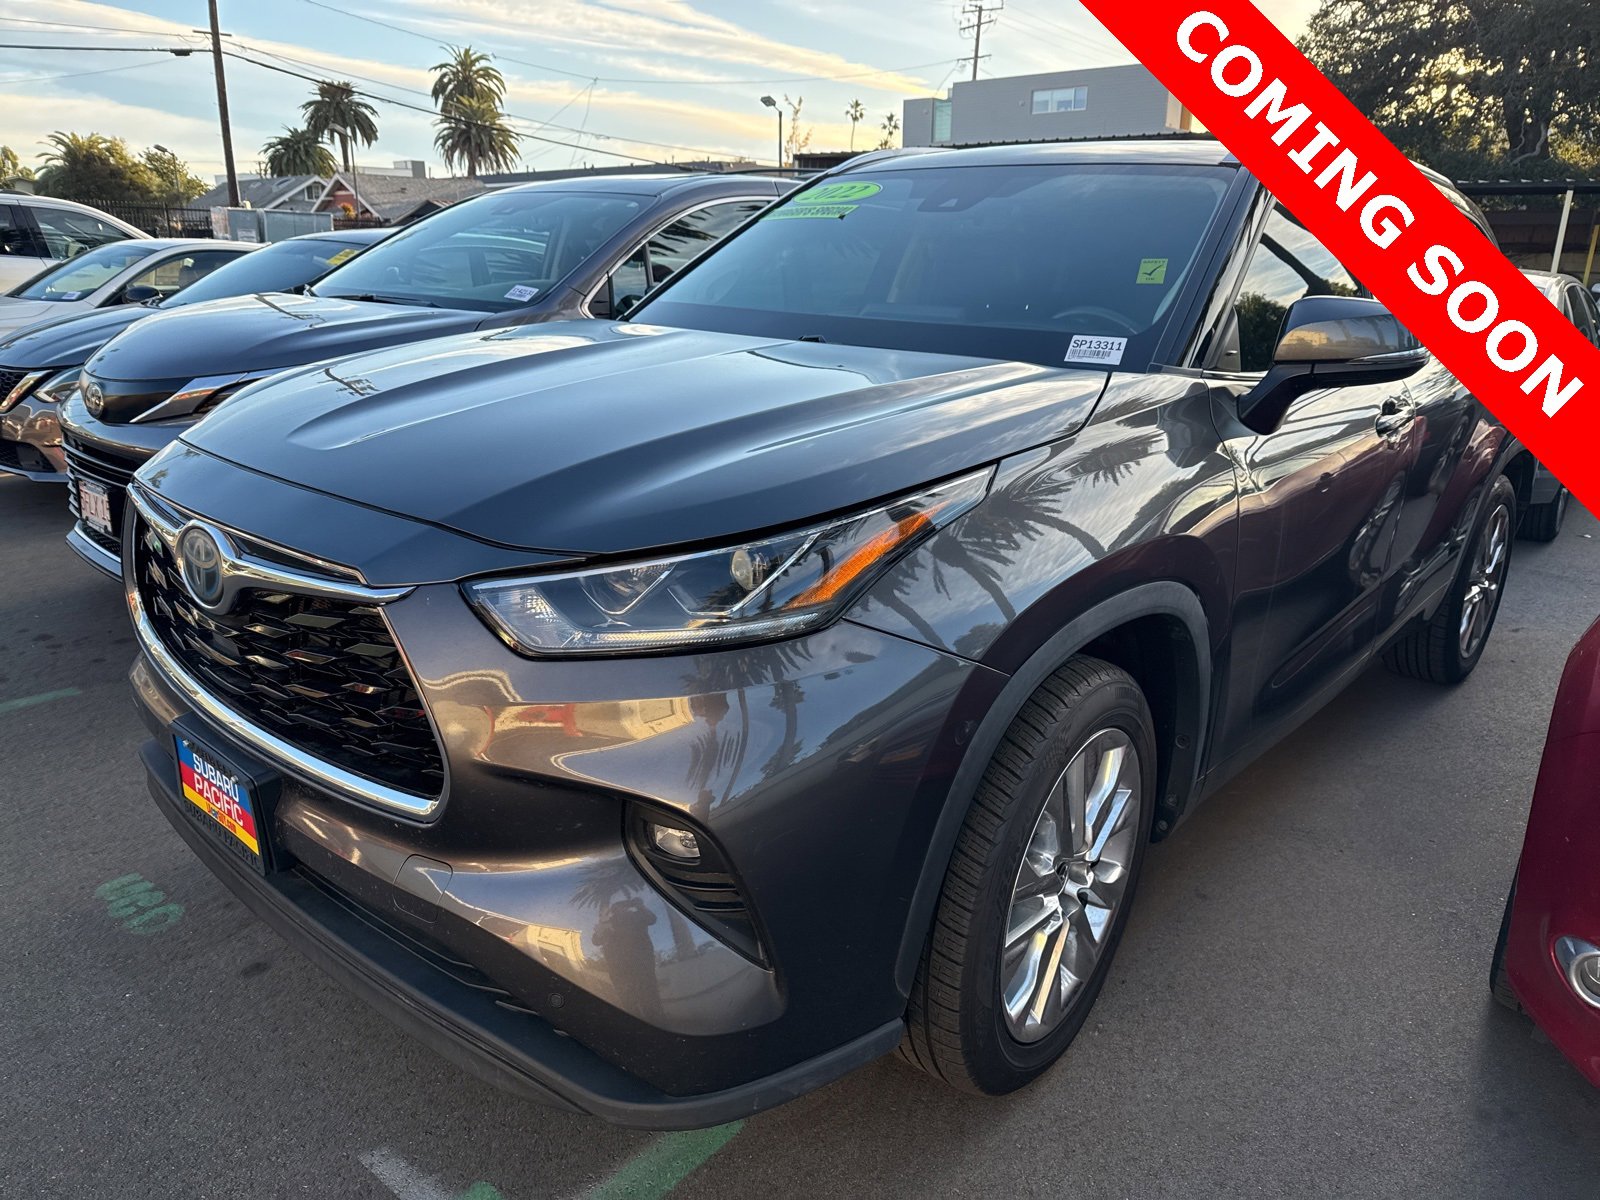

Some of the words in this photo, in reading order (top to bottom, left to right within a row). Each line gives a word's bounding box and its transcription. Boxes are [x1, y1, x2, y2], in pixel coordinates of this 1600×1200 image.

[800, 185, 871, 201] 2022
[1072, 339, 1122, 351] SP13311
[192, 753, 239, 802] SUBARU
[194, 773, 244, 827] PACIFIC
